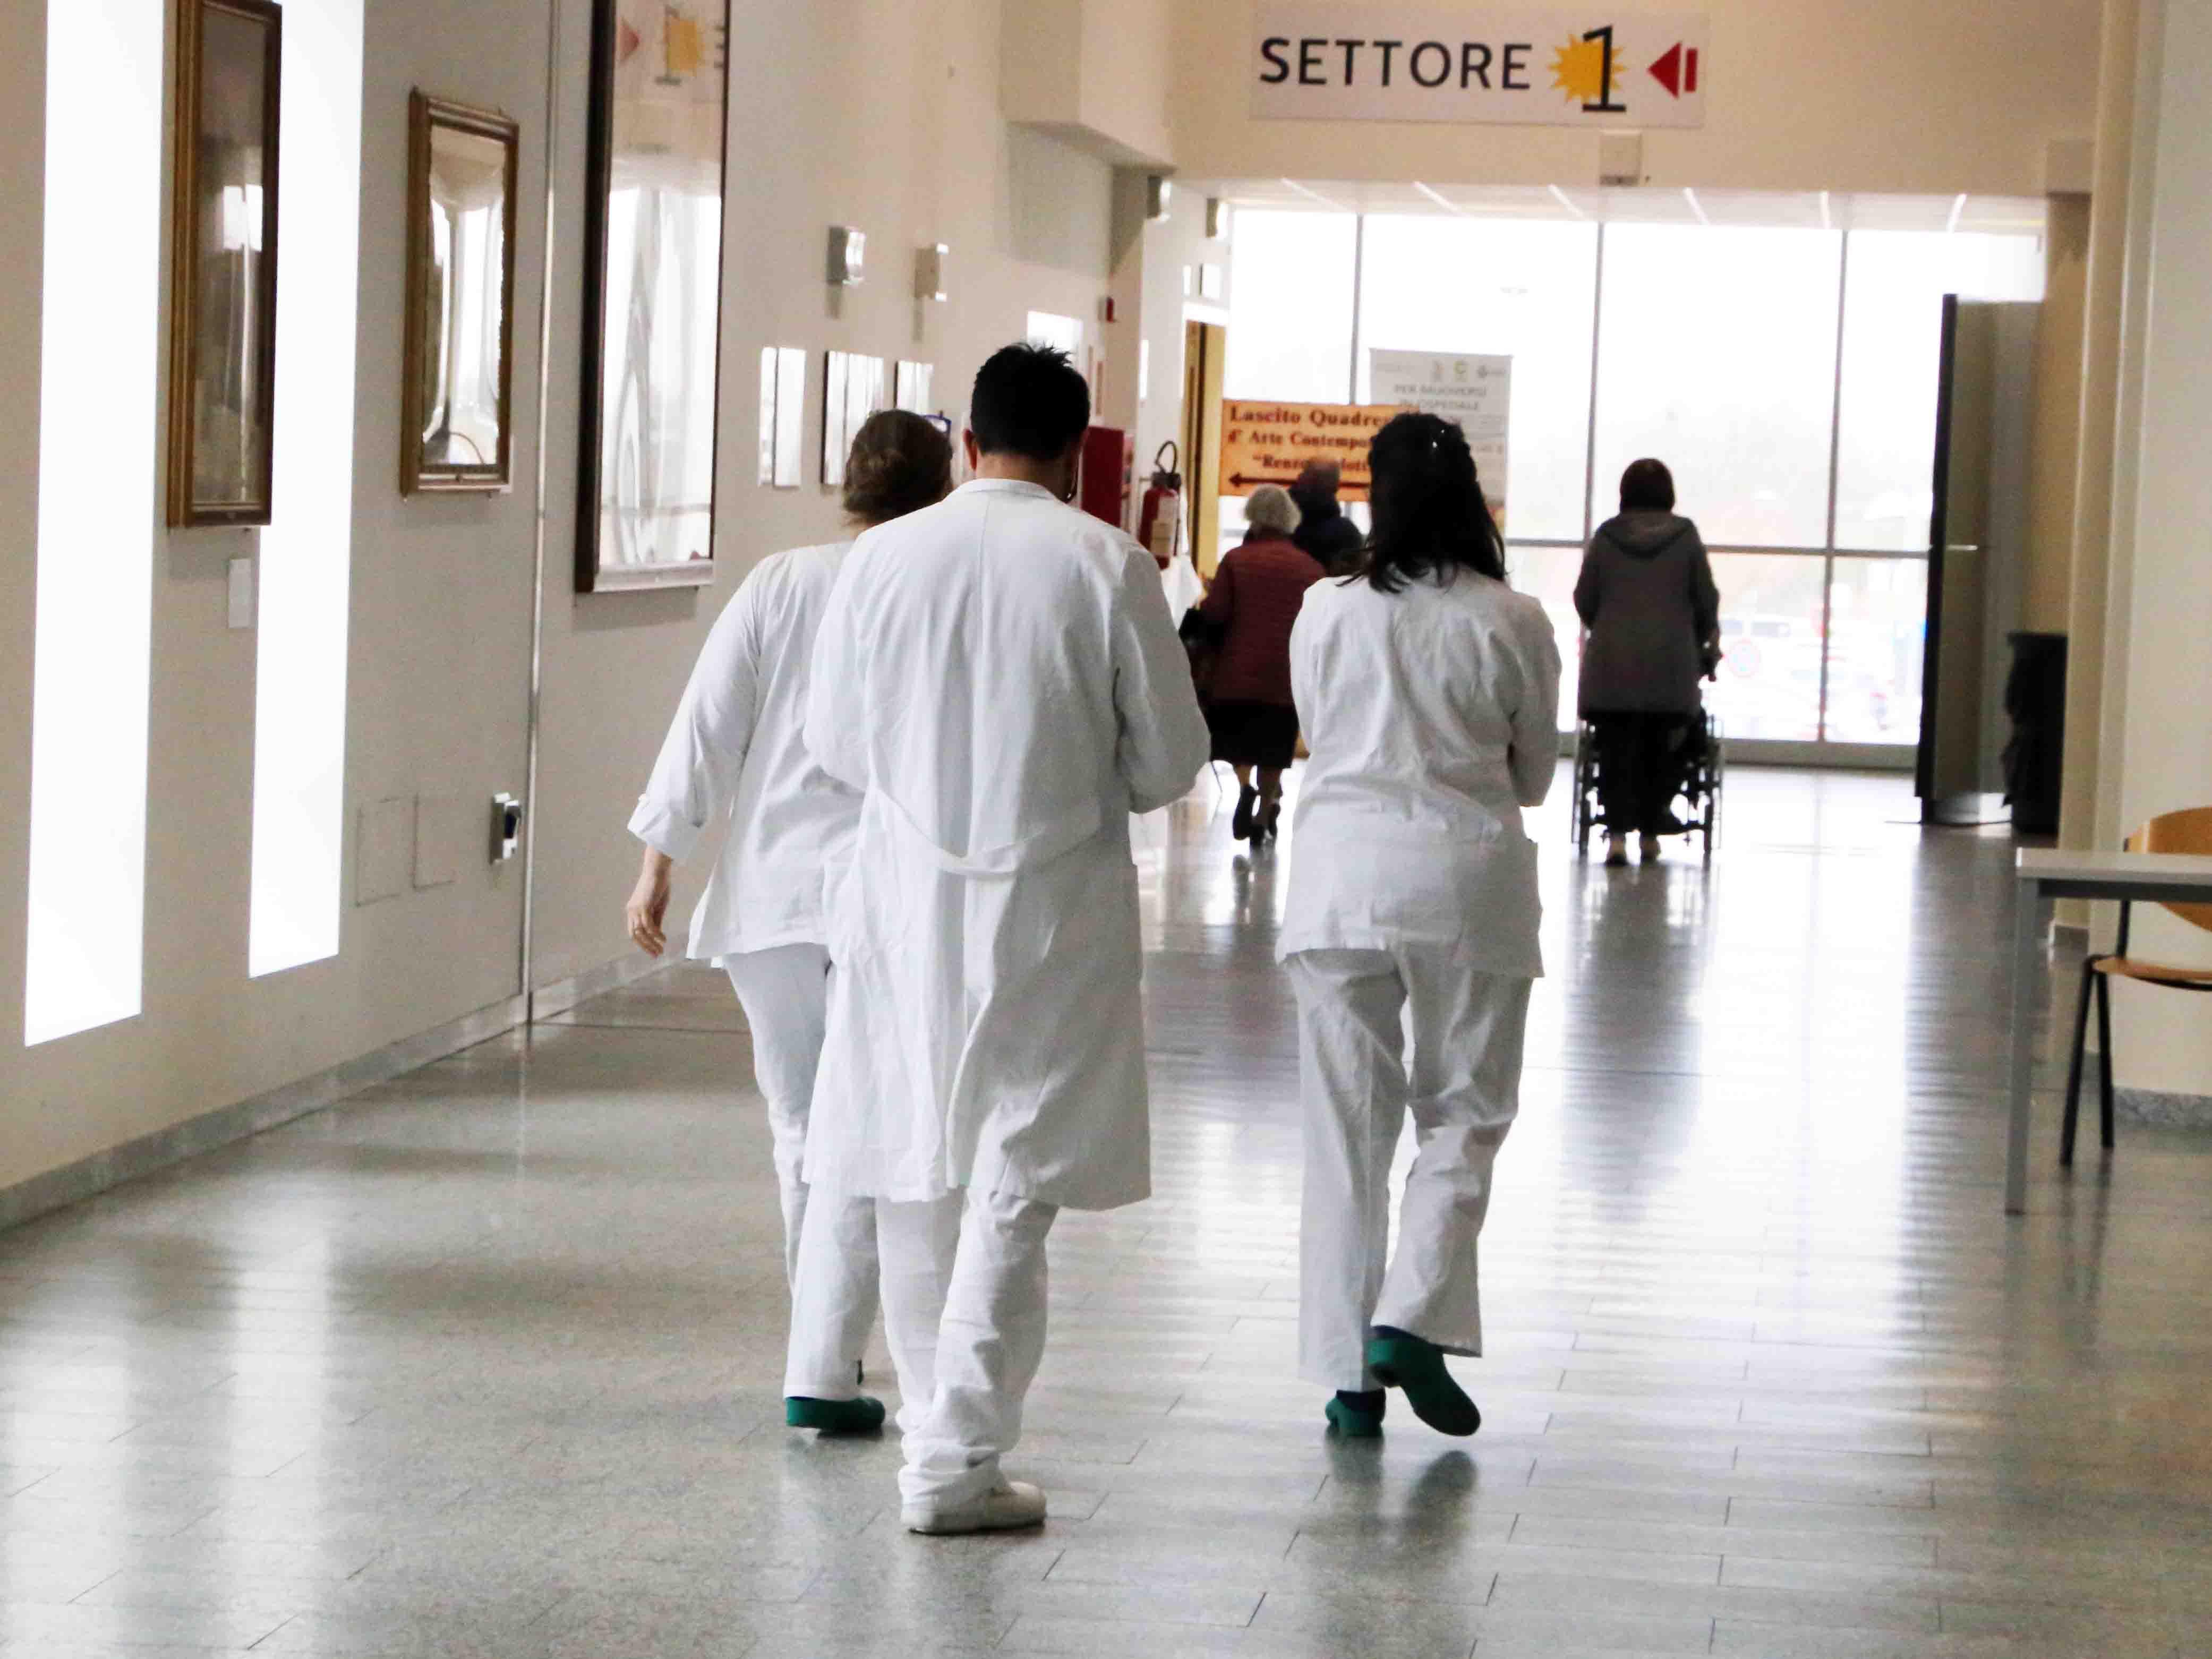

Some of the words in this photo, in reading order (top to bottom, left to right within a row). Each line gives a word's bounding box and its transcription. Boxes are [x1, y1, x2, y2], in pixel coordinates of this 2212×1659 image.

[1259, 37, 1532, 90] SETTORE
[1582, 24, 1627, 113] 1
[1230, 406, 1301, 424] Lascito
[1252, 431, 1283, 445] Arte
